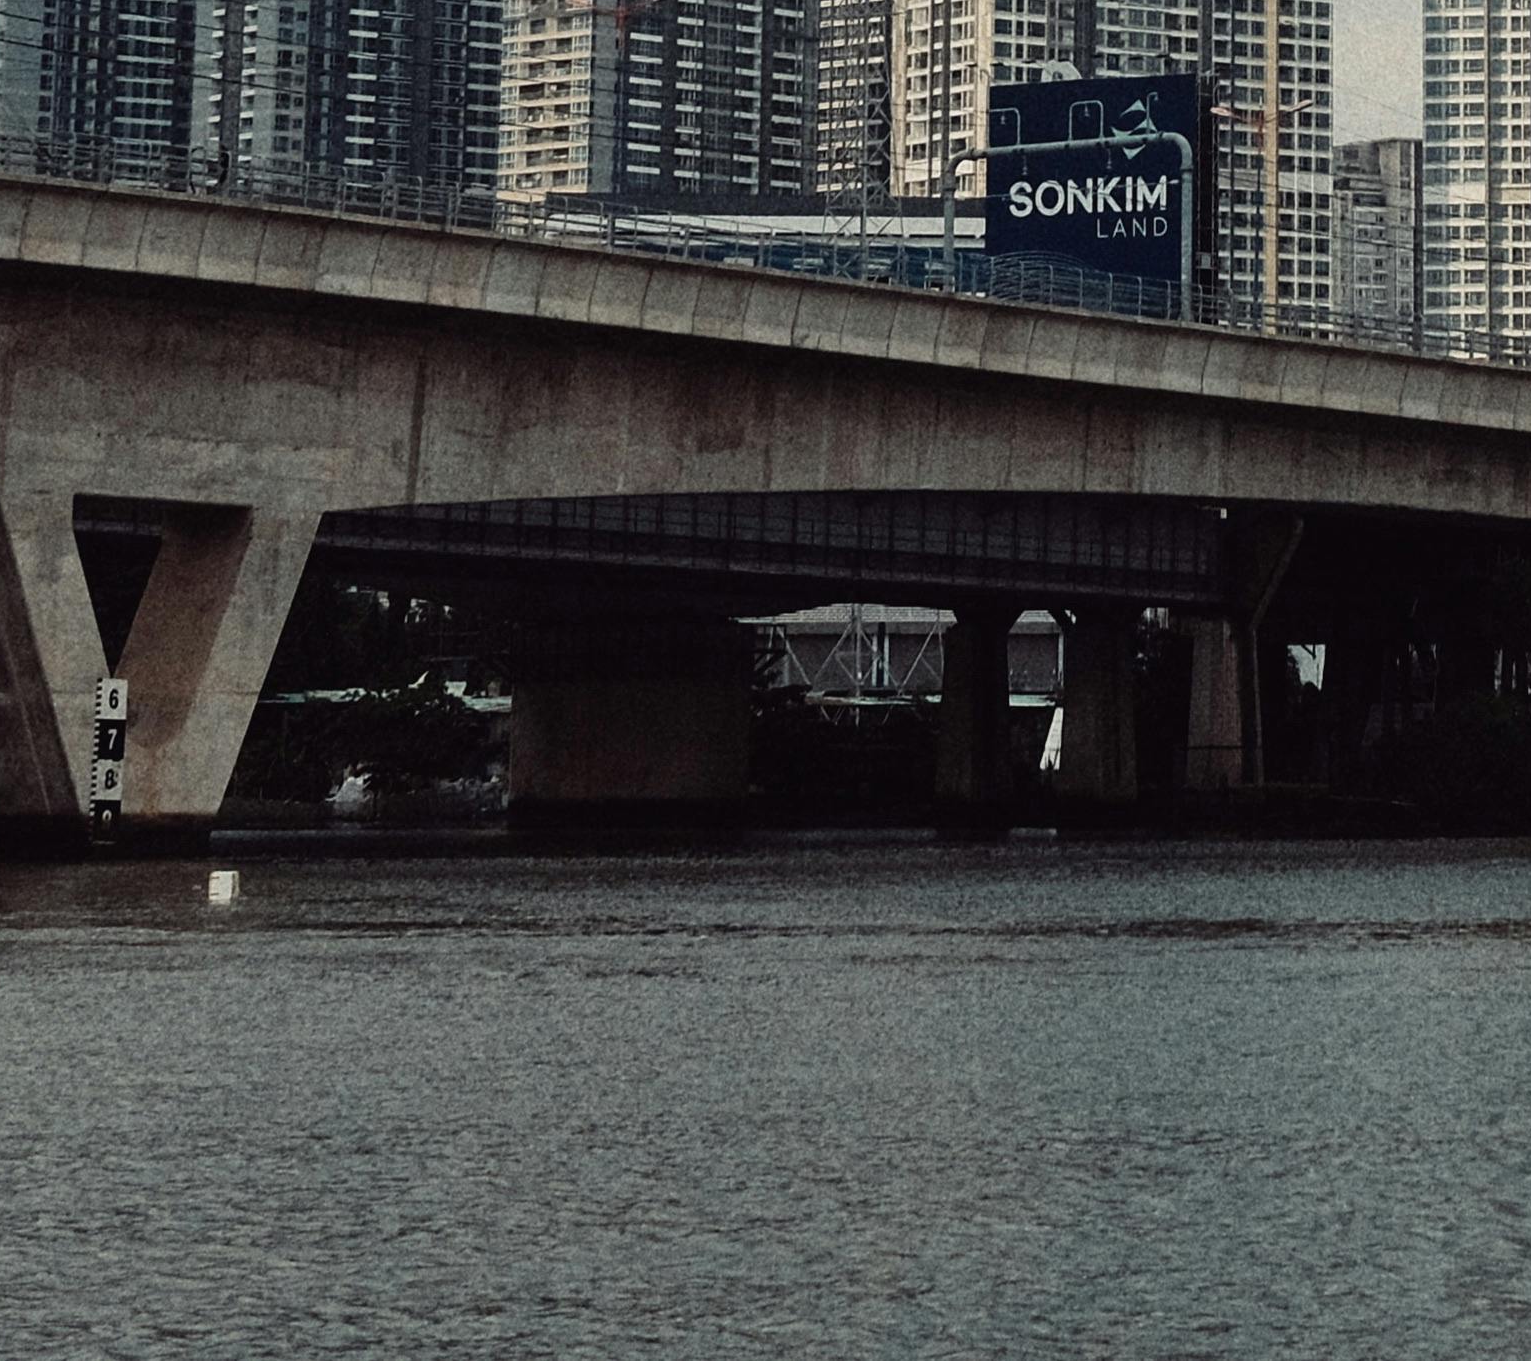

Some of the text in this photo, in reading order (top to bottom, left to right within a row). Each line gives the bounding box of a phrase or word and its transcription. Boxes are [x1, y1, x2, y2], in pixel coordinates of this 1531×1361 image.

[1008, 175, 1167, 218] SONKIM
[1096, 216, 1168, 239] LAND
[108, 688, 119, 710] 6
[107, 729, 117, 751] 7
[104, 769, 115, 790] 8
